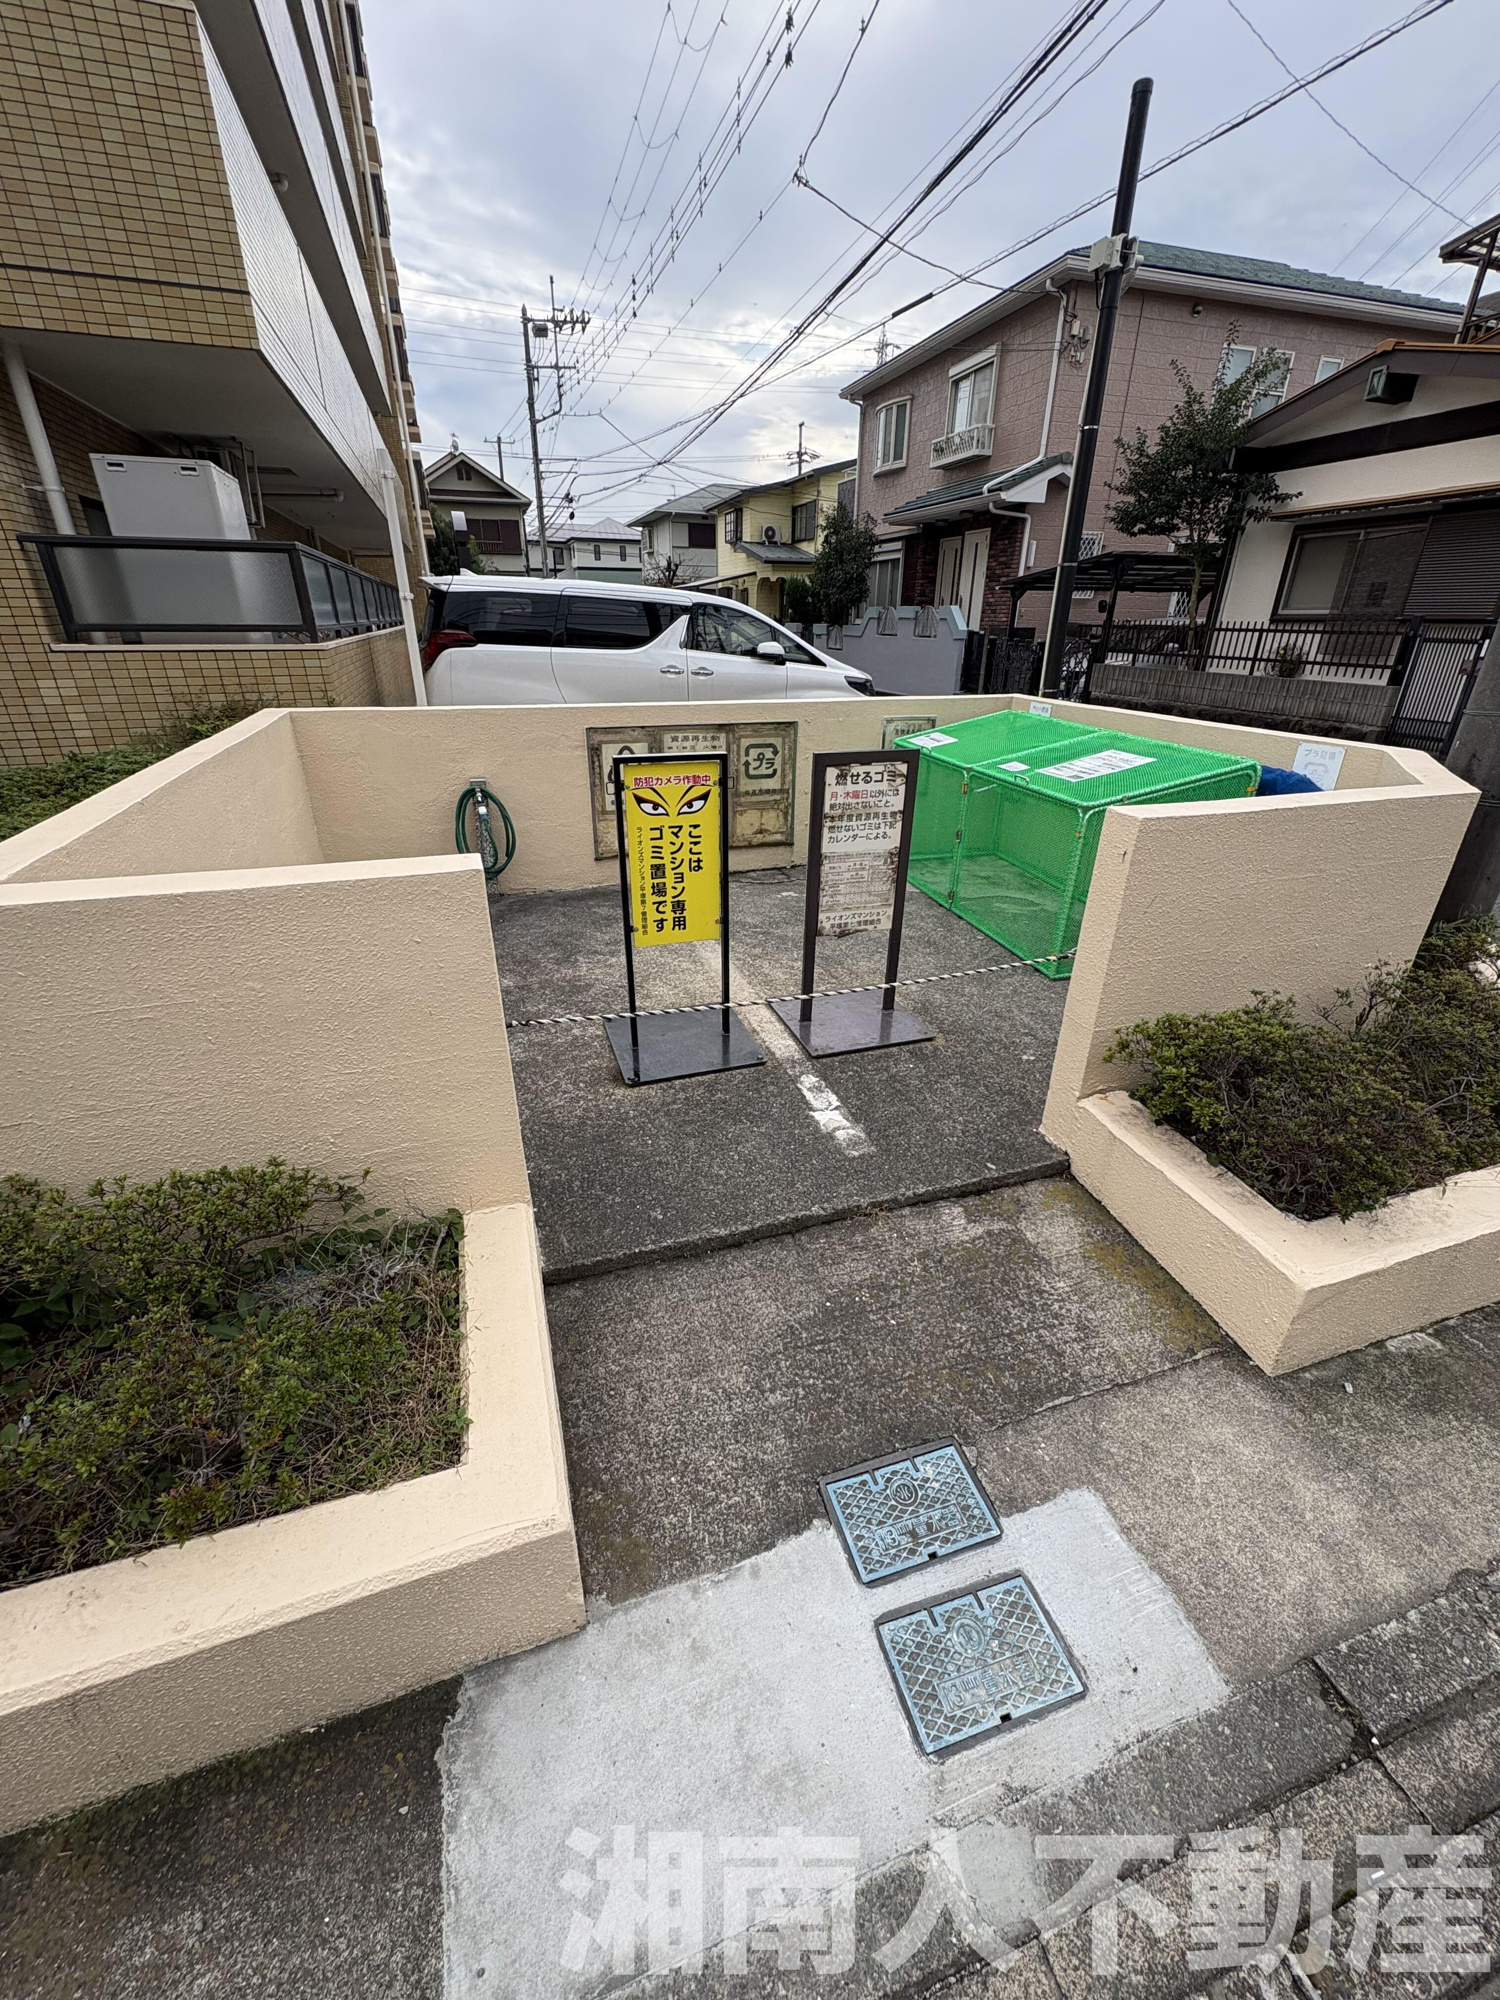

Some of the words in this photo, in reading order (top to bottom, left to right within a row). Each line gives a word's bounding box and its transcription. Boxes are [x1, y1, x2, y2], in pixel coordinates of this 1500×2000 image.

[752, 751, 776, 771] プラ
[633, 774, 711, 788] 防犯カメラ作動中
[835, 770, 897, 787] 燃せるゴミ
[829, 799, 895, 811] 絶対出さないこと。
[828, 811, 898, 823] 本年度資源再生物
[827, 820, 898, 834] 燃せないゴミは下記
[827, 831, 892, 844] カレンダーによる。
[688, 823, 704, 873] ここは
[649, 825, 668, 933] ゴミ置場です
[668, 825, 687, 931] マンション専用
[825, 910, 888, 923] ライオンズマンション
